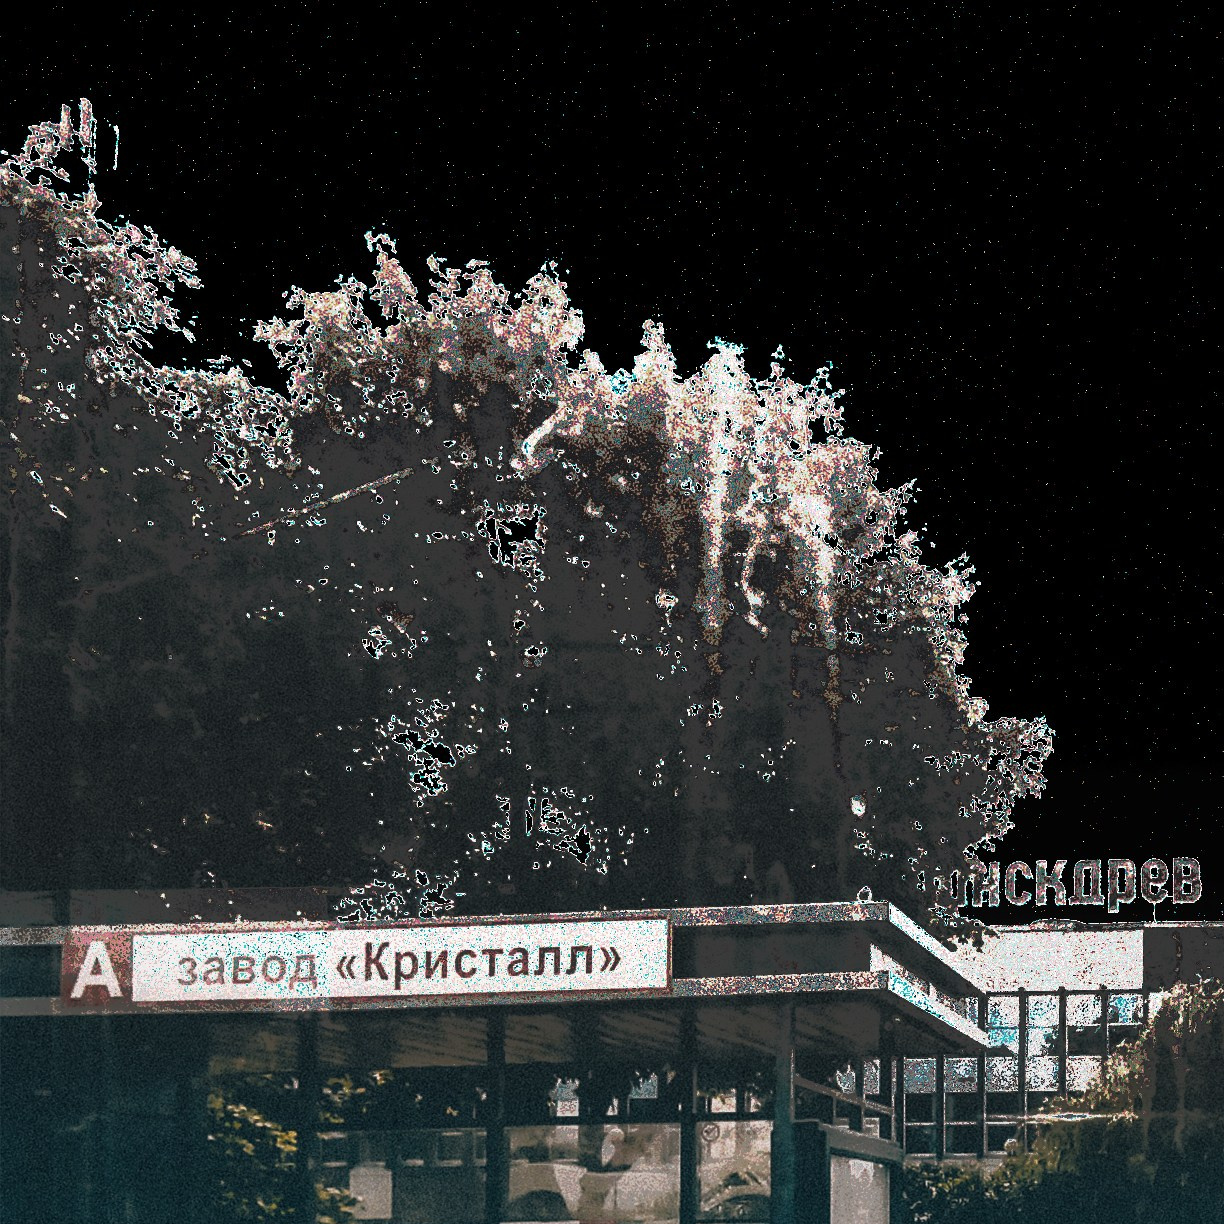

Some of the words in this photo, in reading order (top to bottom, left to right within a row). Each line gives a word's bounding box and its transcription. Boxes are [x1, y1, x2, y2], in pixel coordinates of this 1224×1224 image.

[70, 940, 125, 999] А
[176, 954, 319, 991] завод
[335, 941, 622, 991] «Кристалл»
